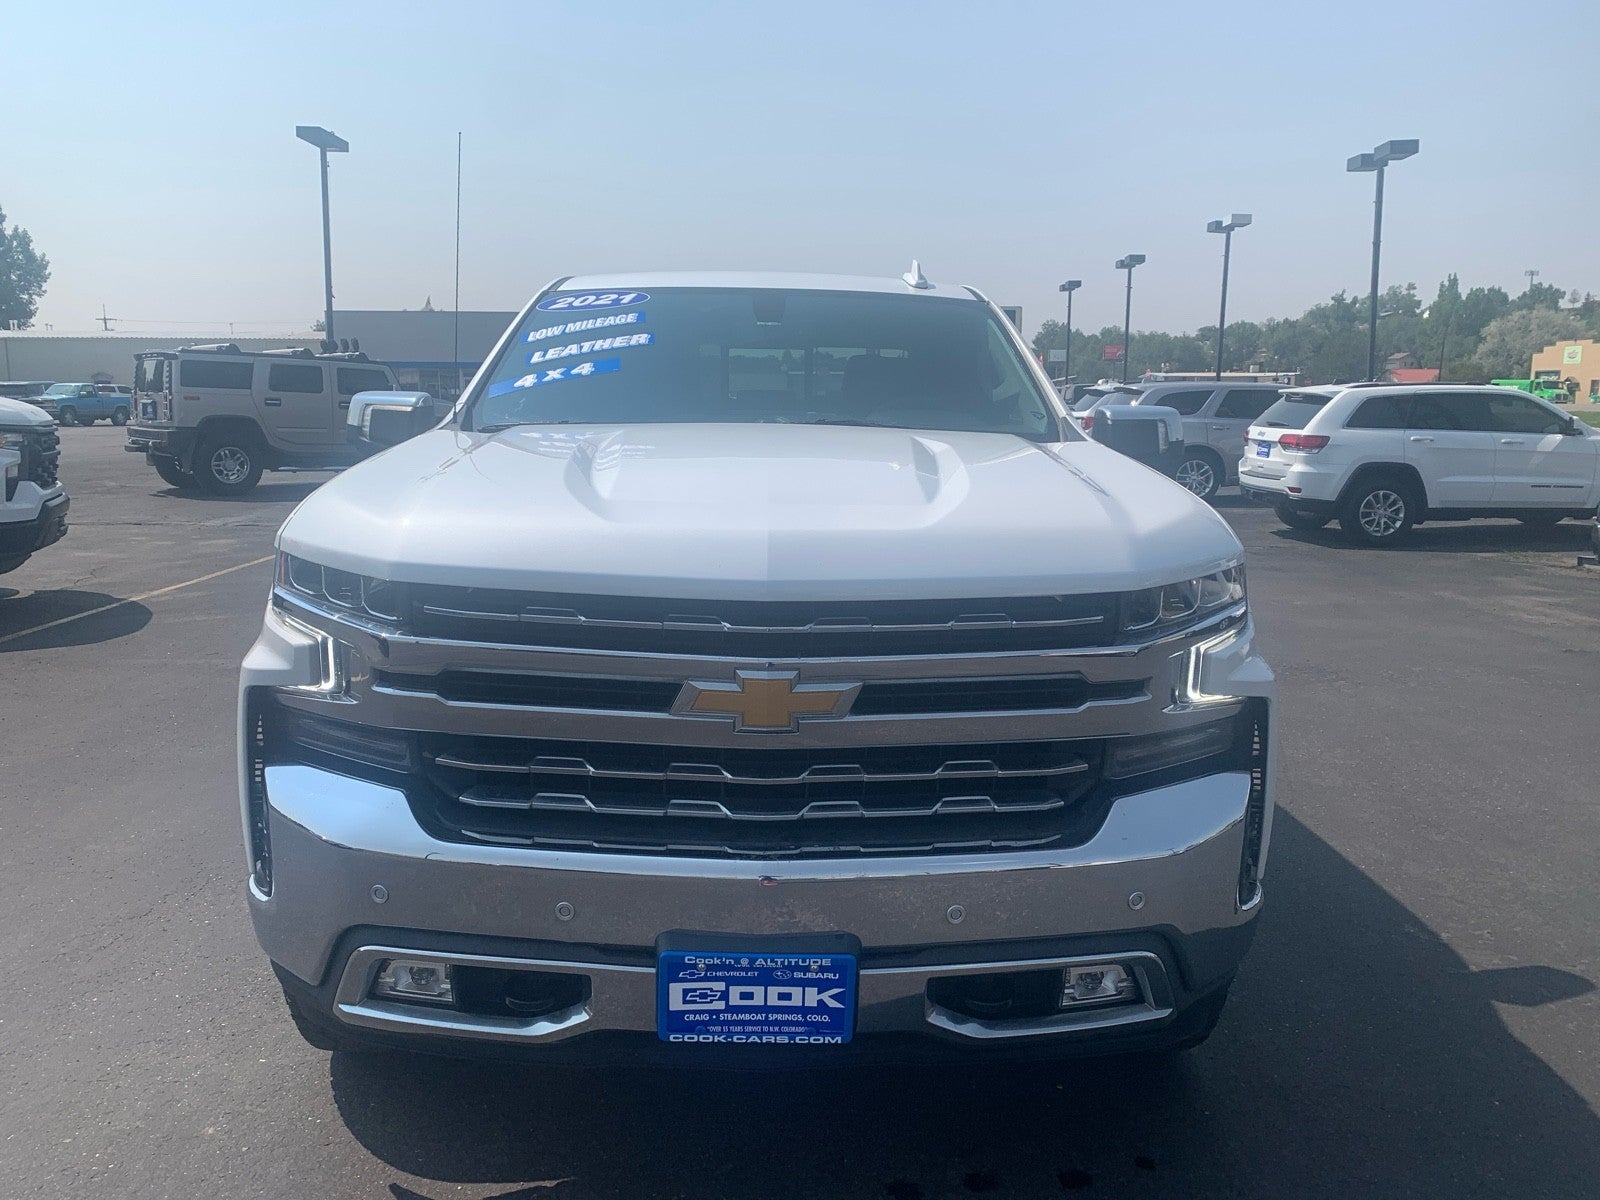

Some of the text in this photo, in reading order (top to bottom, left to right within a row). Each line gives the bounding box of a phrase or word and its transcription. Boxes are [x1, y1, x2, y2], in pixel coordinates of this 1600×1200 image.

[548, 293, 638, 310] 2021
[526, 312, 639, 342] LOW MILEAGE
[530, 333, 652, 364] LEATHER
[684, 956, 735, 965] Cook'n
[754, 958, 832, 966] ALTITUDE
[793, 971, 839, 979] SUBARU
[669, 982, 846, 1010] COOK
[719, 1013, 766, 1021] STEAMBOAT
[768, 1013, 805, 1022] SPRINGS,
[806, 1014, 831, 1022] COLO.
[669, 1034, 842, 1043] COOK-CARS.COM
